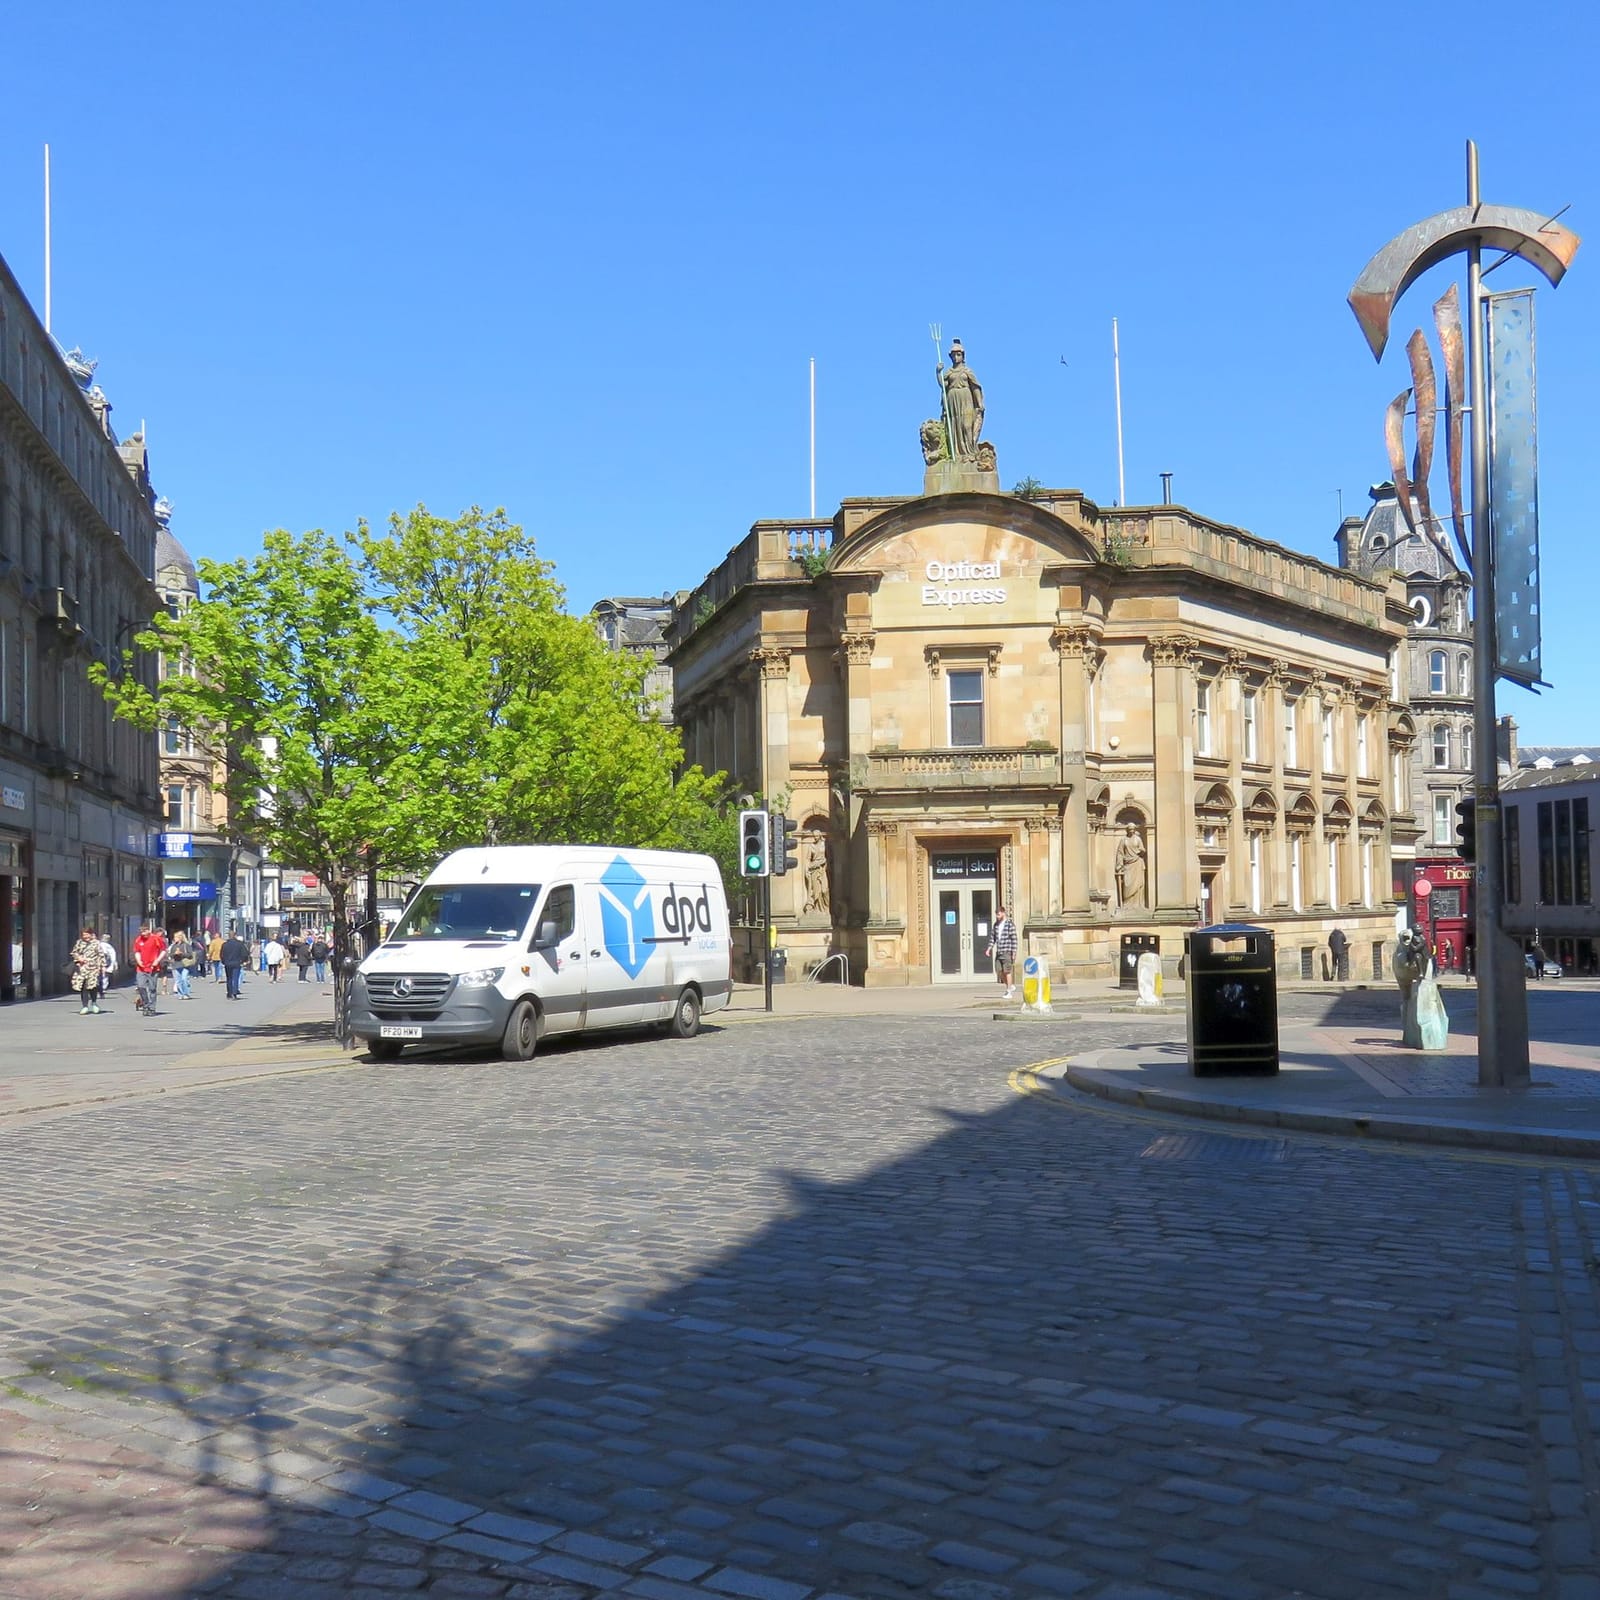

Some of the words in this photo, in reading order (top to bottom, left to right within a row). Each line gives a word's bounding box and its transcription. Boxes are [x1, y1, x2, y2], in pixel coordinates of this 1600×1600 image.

[926, 560, 1001, 586] Optical
[922, 584, 1008, 610] Express
[937, 859, 963, 869] Optical
[662, 882, 711, 947] dpd
[382, 1027, 402, 1036] PF20
